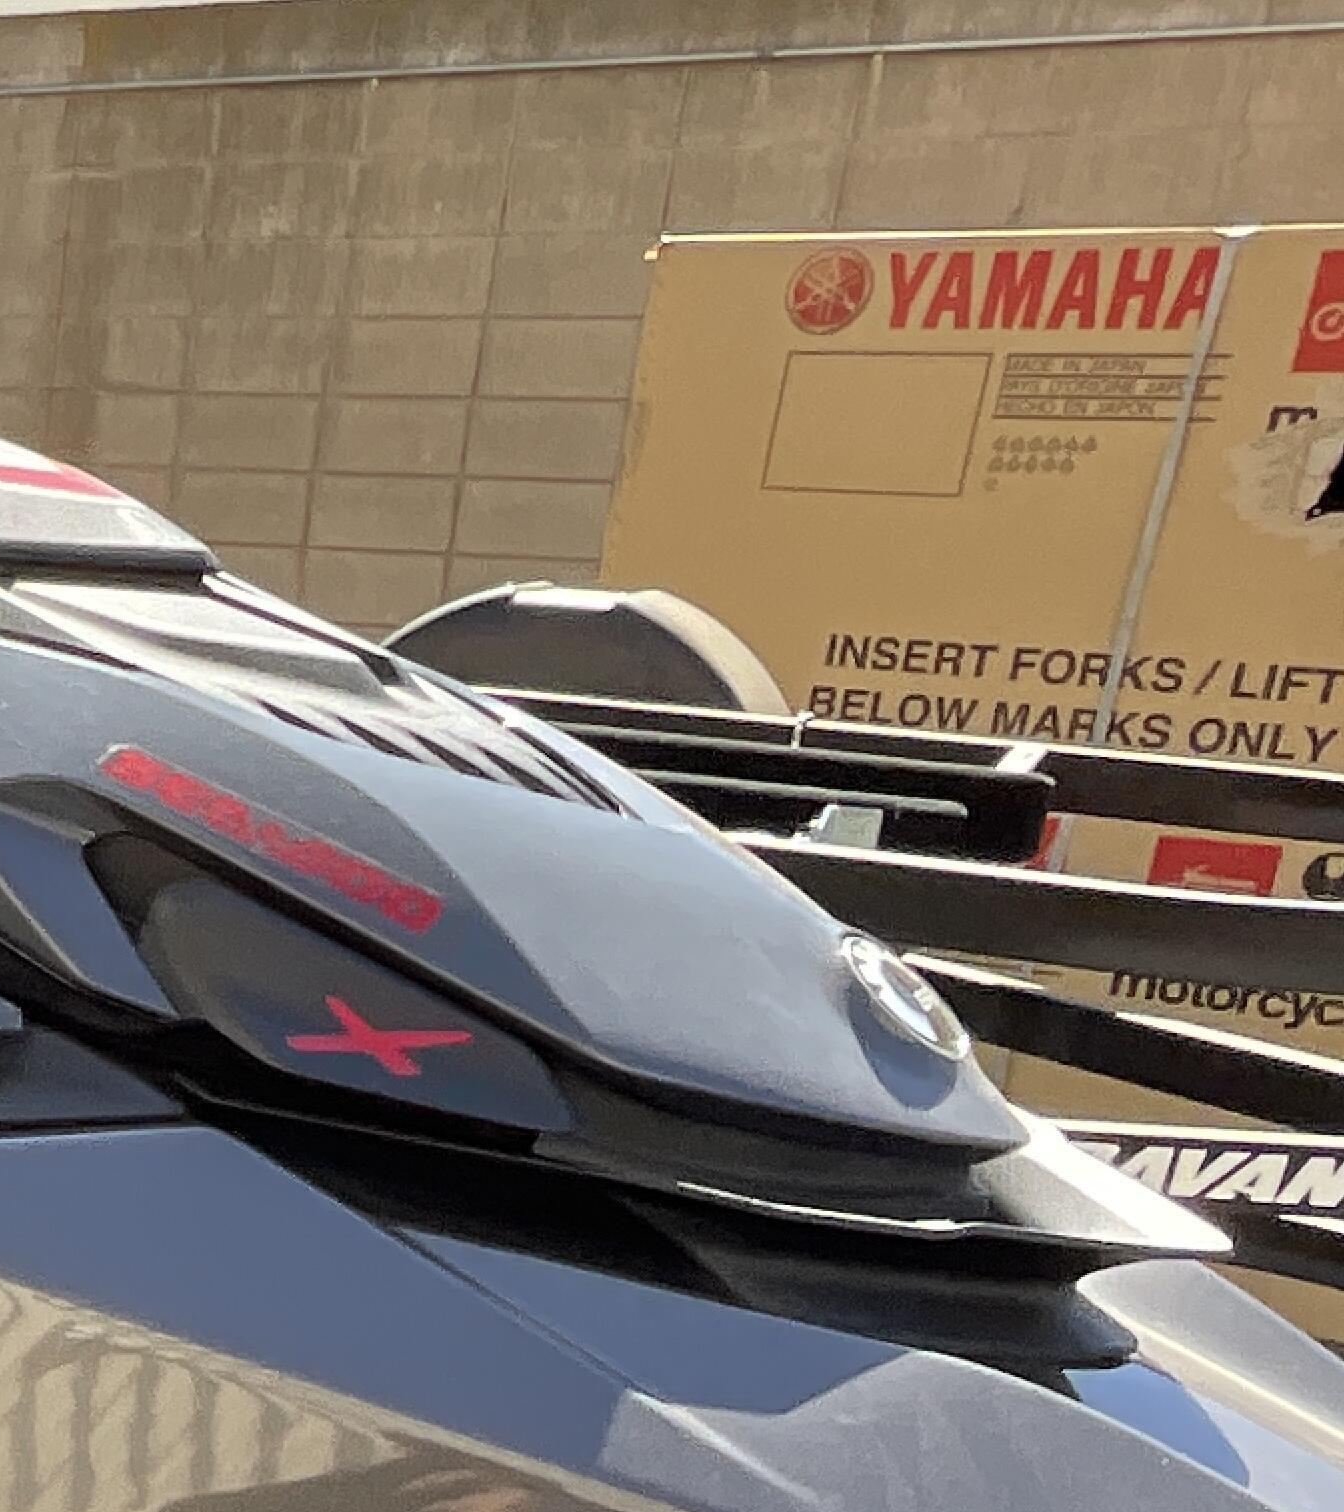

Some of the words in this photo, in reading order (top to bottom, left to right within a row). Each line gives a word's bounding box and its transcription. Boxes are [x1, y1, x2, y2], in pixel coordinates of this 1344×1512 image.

[889, 247, 1221, 330] YAMAHA
[824, 634, 997, 679] INSERT
[1008, 647, 1187, 693] FORKS
[1230, 662, 1344, 704] LIFT
[808, 685, 978, 730] BELOW
[1189, 717, 1338, 762] ONLY
